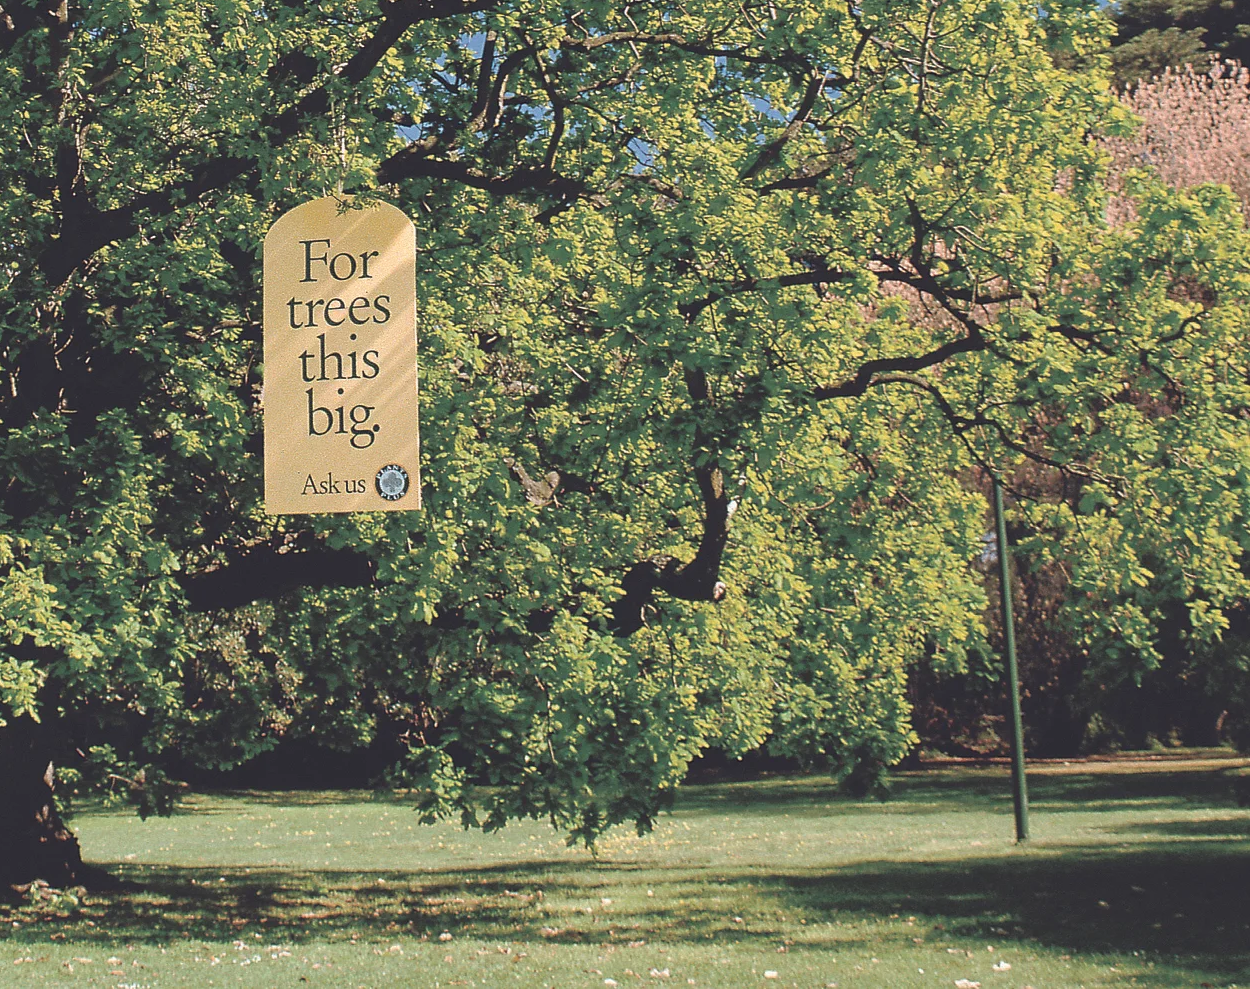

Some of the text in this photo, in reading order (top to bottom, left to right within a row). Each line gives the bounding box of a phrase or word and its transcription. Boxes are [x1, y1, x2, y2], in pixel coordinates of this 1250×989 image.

[299, 238, 380, 283] For
[286, 294, 391, 329] trees
[298, 333, 380, 383] this
[305, 387, 381, 449] big.
[301, 472, 367, 495] Ask us
[380, 491, 406, 501] PLUS
